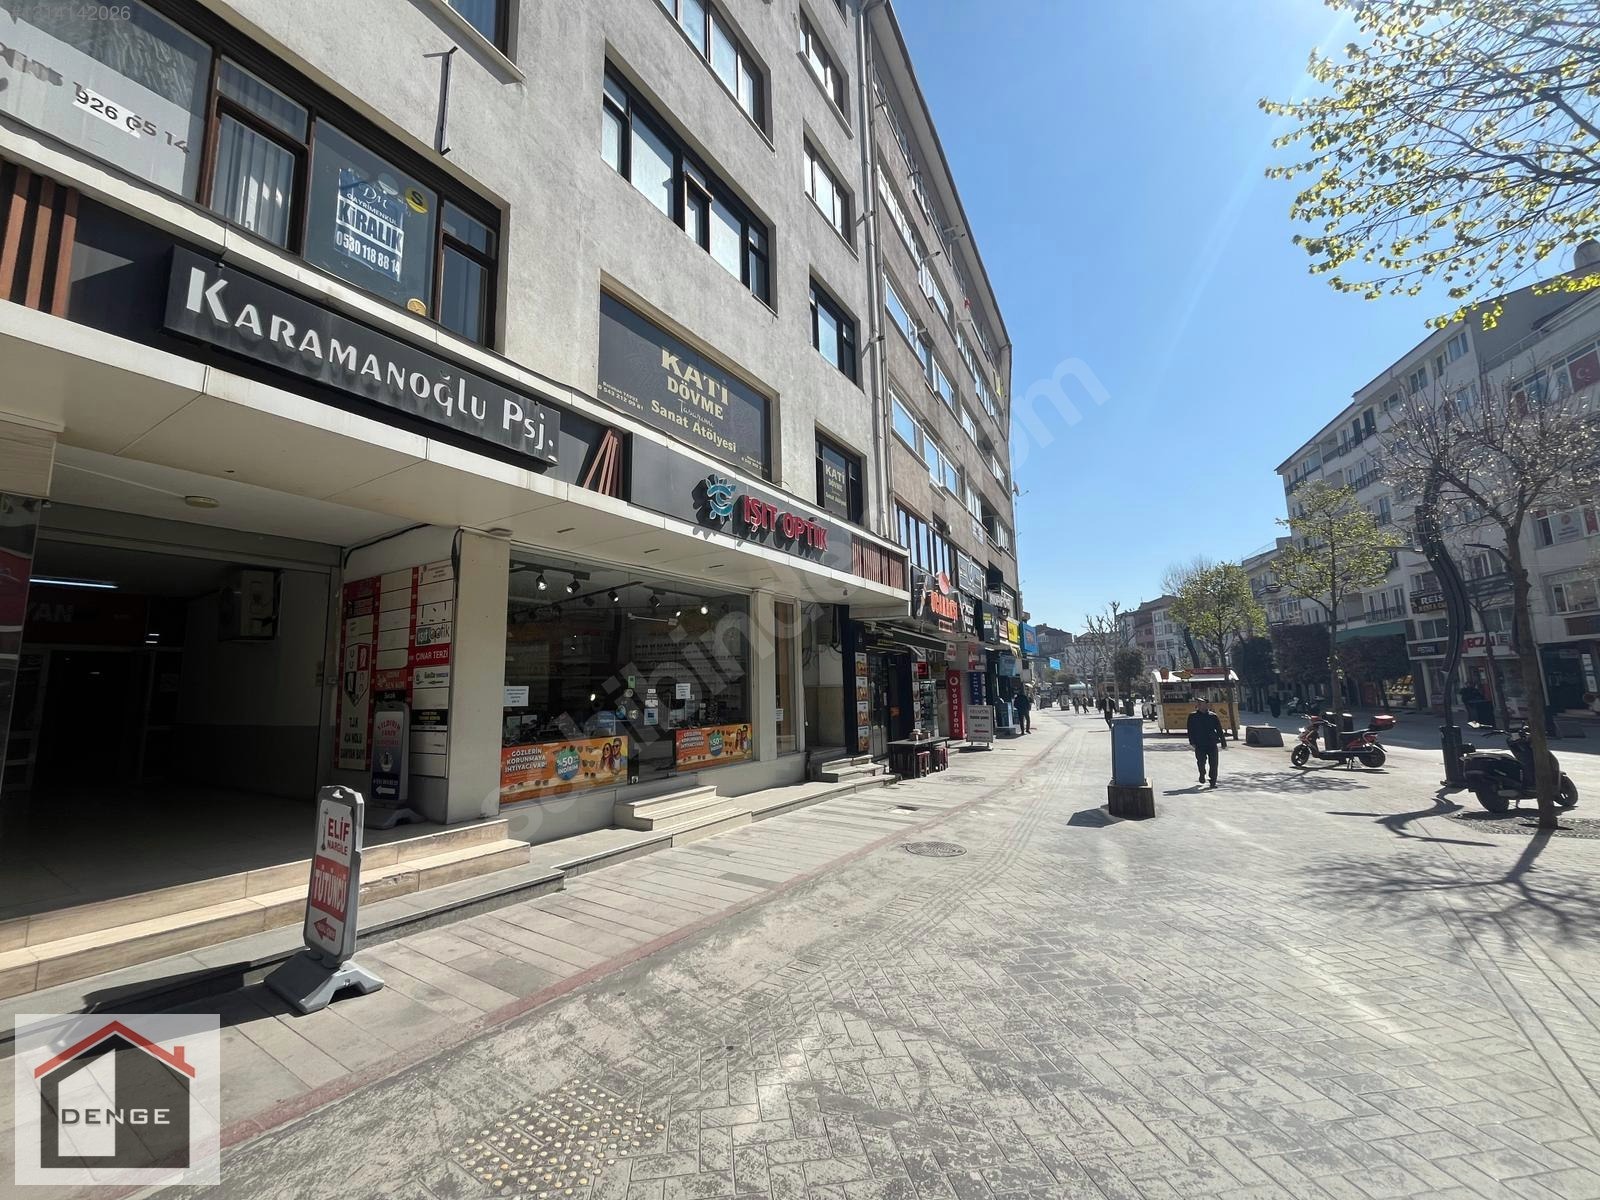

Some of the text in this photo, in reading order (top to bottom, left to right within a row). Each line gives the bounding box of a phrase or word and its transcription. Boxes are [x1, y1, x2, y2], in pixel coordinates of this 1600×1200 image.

[667, 375, 724, 421] DÖVME
[651, 399, 737, 454] Sanat Atölyesi
[506, 754, 546, 766] KORUNMAYA
[327, 816, 350, 842] ELİF
